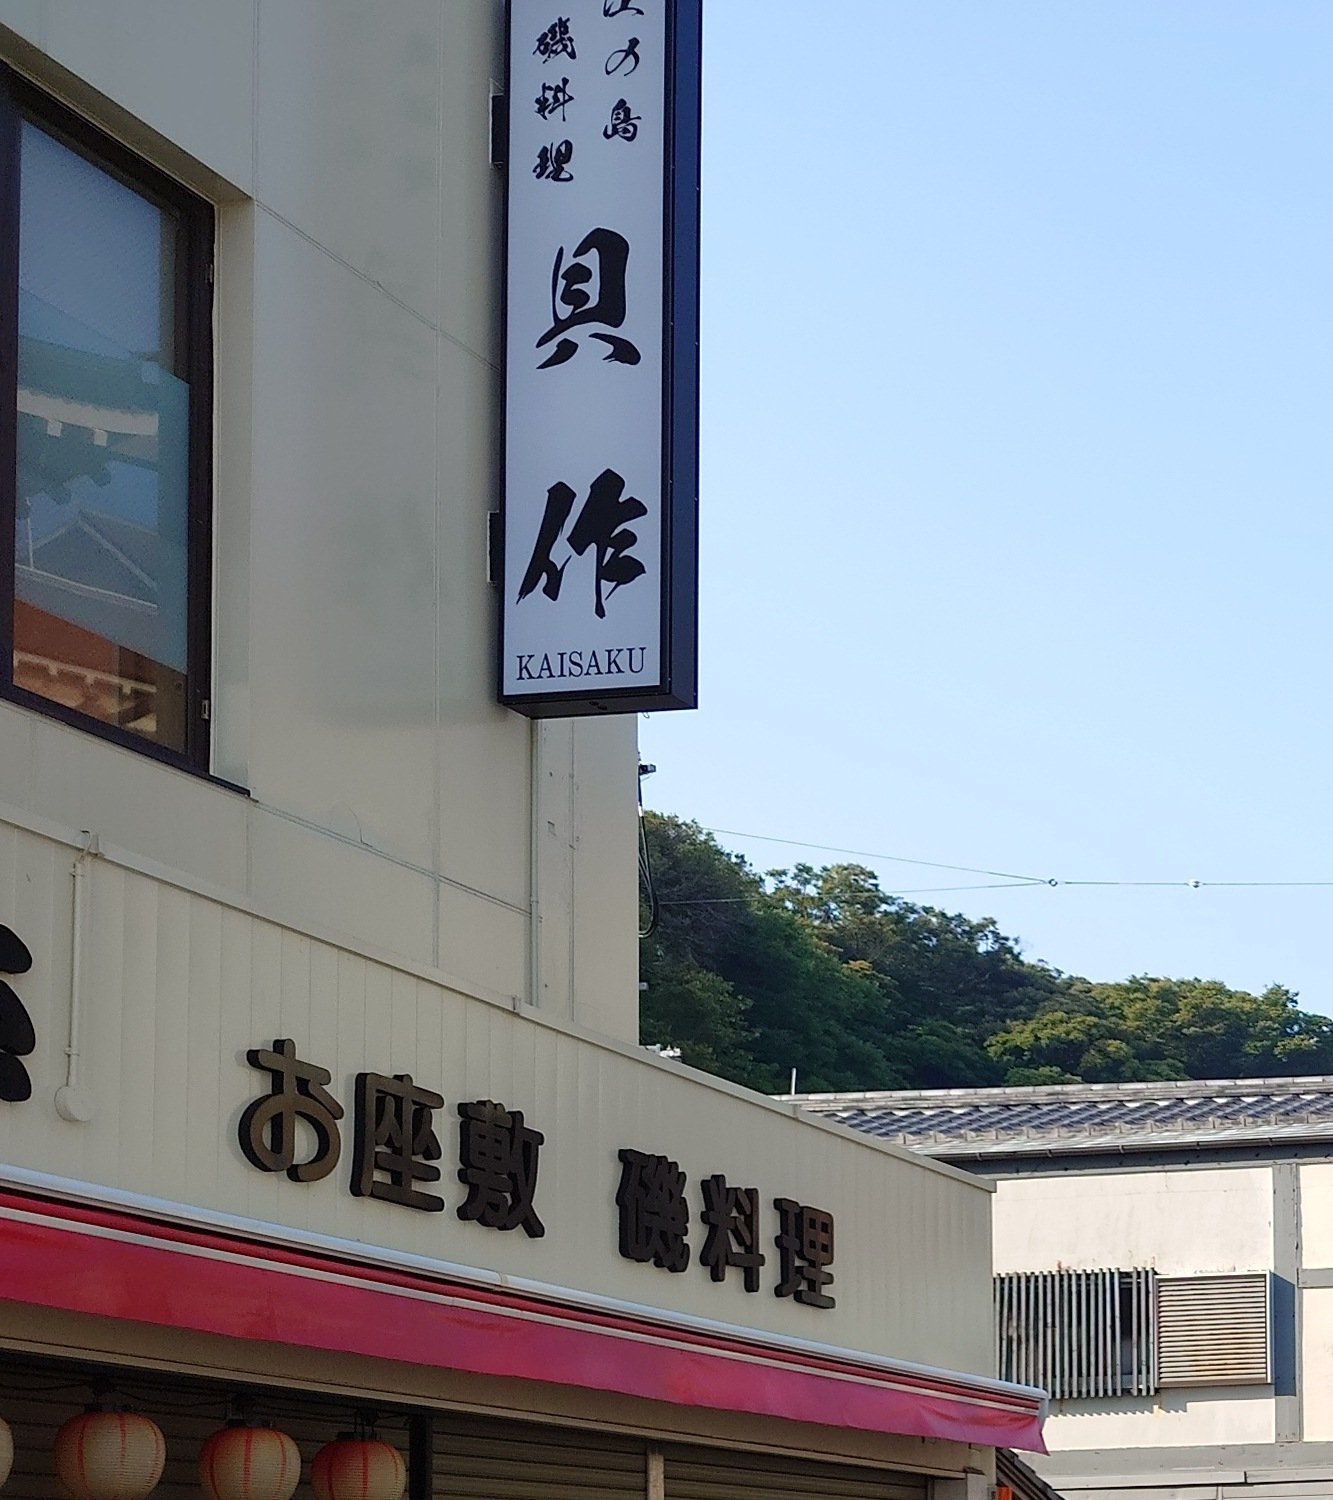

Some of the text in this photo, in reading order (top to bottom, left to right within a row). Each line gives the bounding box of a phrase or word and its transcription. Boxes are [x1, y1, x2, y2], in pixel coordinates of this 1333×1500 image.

[532, 16, 577, 183] 磯料理
[515, 226, 648, 619] 貝作
[515, 645, 648, 683] KAISAKU
[238, 1038, 836, 1310] お座敷 磯料理
